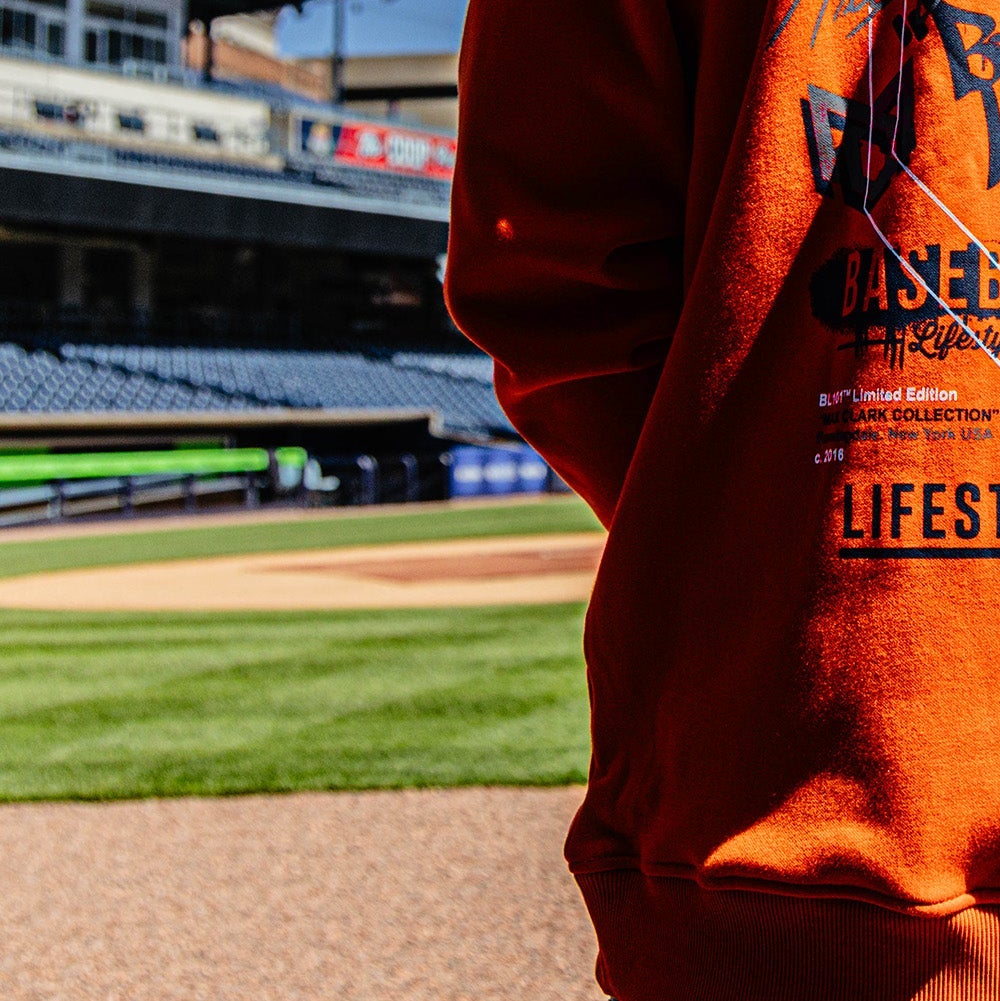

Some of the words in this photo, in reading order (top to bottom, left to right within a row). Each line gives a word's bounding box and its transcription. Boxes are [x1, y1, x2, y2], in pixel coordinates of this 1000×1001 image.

[852, 387, 901, 402] Limited
[905, 386, 959, 402] Edition
[842, 408, 888, 424] CLARK
[922, 427, 956, 441] York
[960, 426, 994, 441] USA
